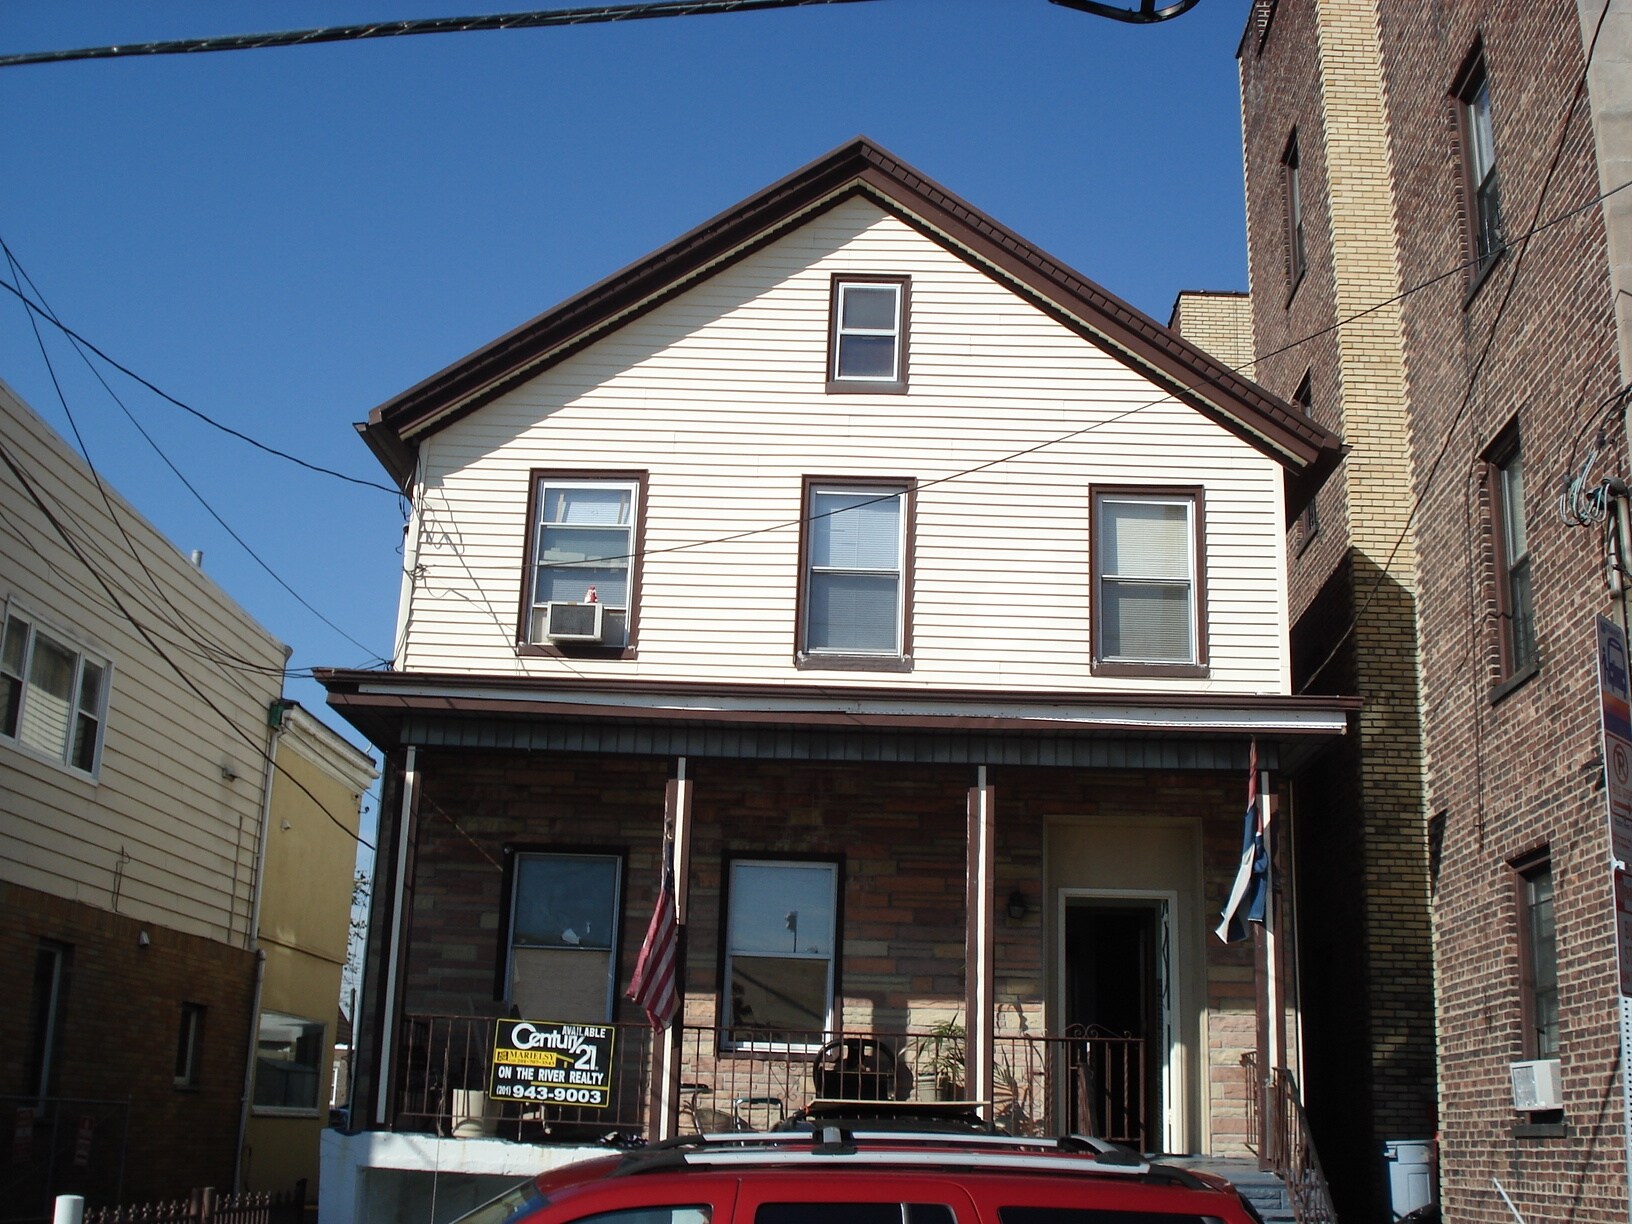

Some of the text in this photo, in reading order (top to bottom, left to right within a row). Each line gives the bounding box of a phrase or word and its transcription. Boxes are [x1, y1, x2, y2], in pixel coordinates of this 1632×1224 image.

[562, 1025, 606, 1038] AVAILABLE
[511, 1022, 598, 1071] Century 21
[498, 1066, 604, 1085] ON THE RIVER REALTY
[496, 1084, 602, 1104] (201) 943-9003
